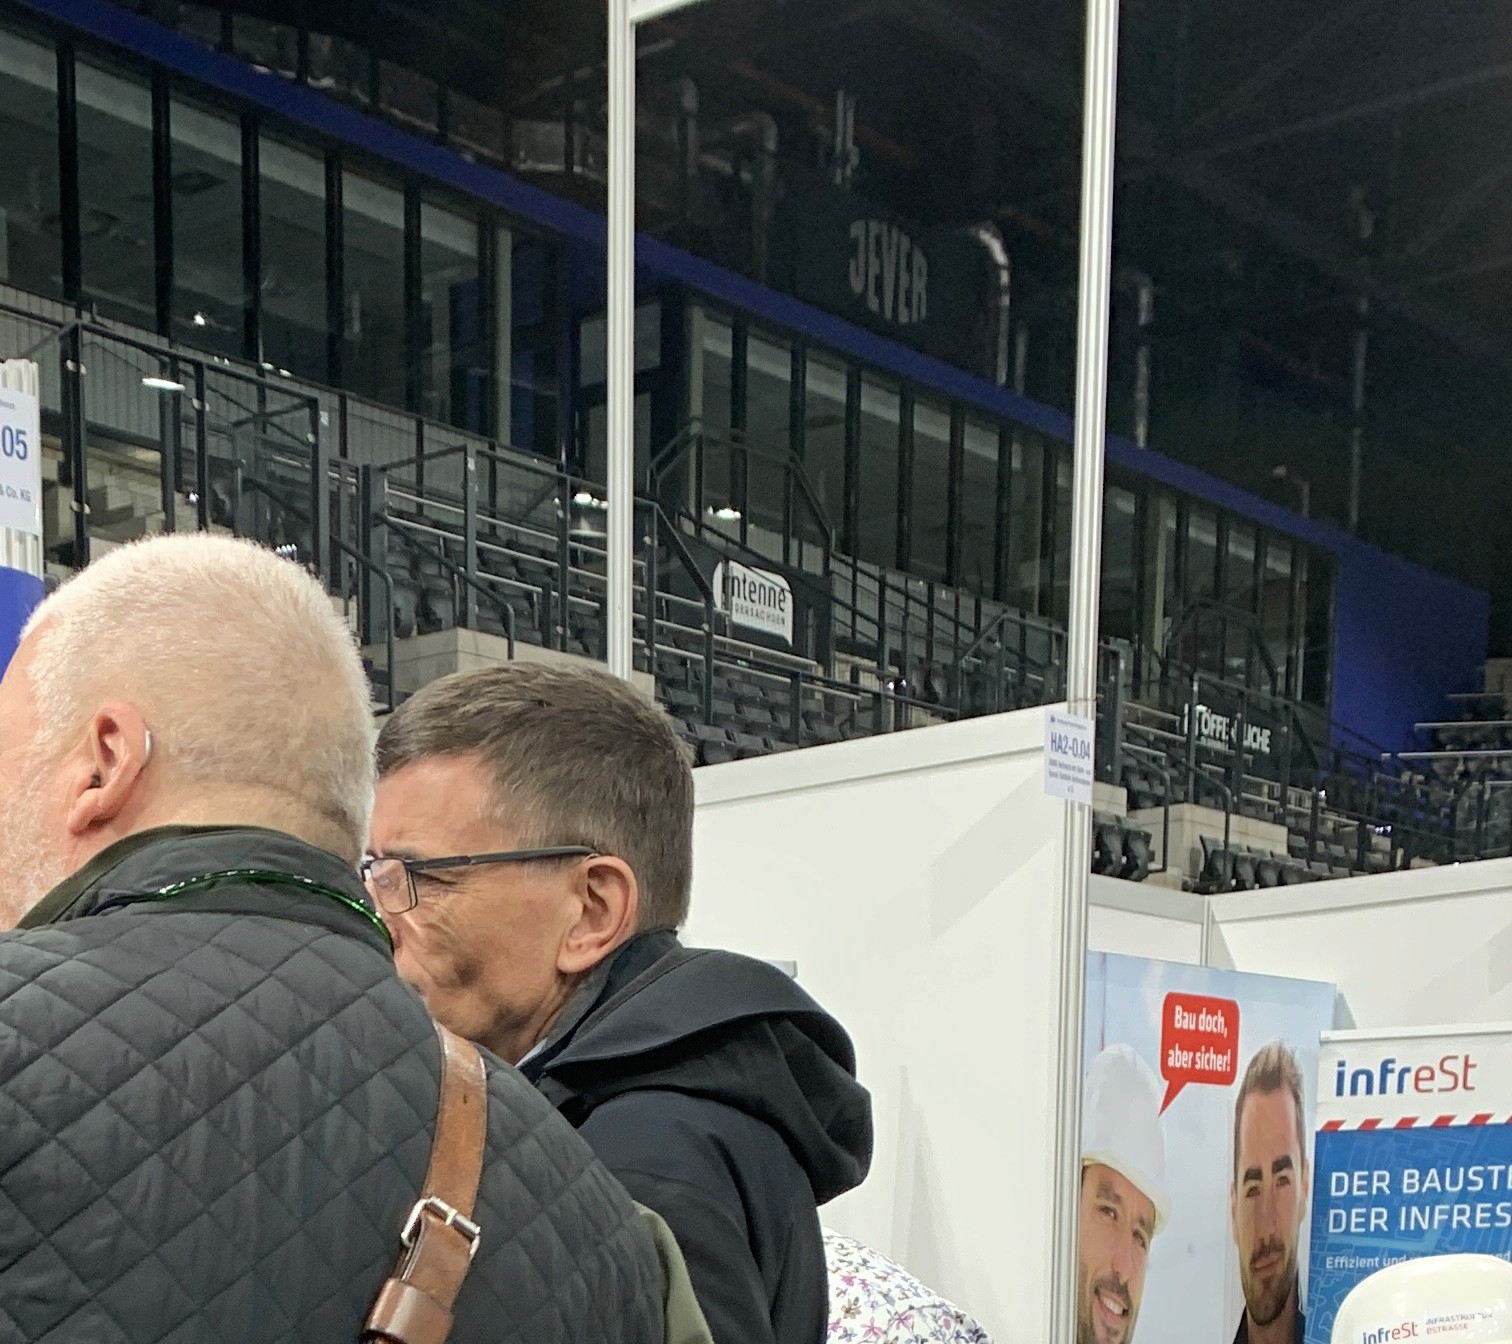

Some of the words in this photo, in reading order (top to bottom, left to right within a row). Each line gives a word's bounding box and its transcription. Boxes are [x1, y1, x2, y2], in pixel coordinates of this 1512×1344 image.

[849, 219, 928, 324] JEVER
[20, 488, 31, 502] KG
[1051, 732, 1091, 761] HA2-0.04
[1174, 1005, 1197, 1031] Bau
[1198, 1007, 1228, 1038] doch,
[1167, 1043, 1194, 1069] aber
[1195, 1045, 1232, 1072] sicher!
[1335, 1054, 1478, 1097] infreSt
[1330, 1170, 1391, 1197] DER
[1328, 1206, 1389, 1234] DER
[1400, 1201, 1512, 1232] INFRES
[1326, 1255, 1380, 1270] Effizient
